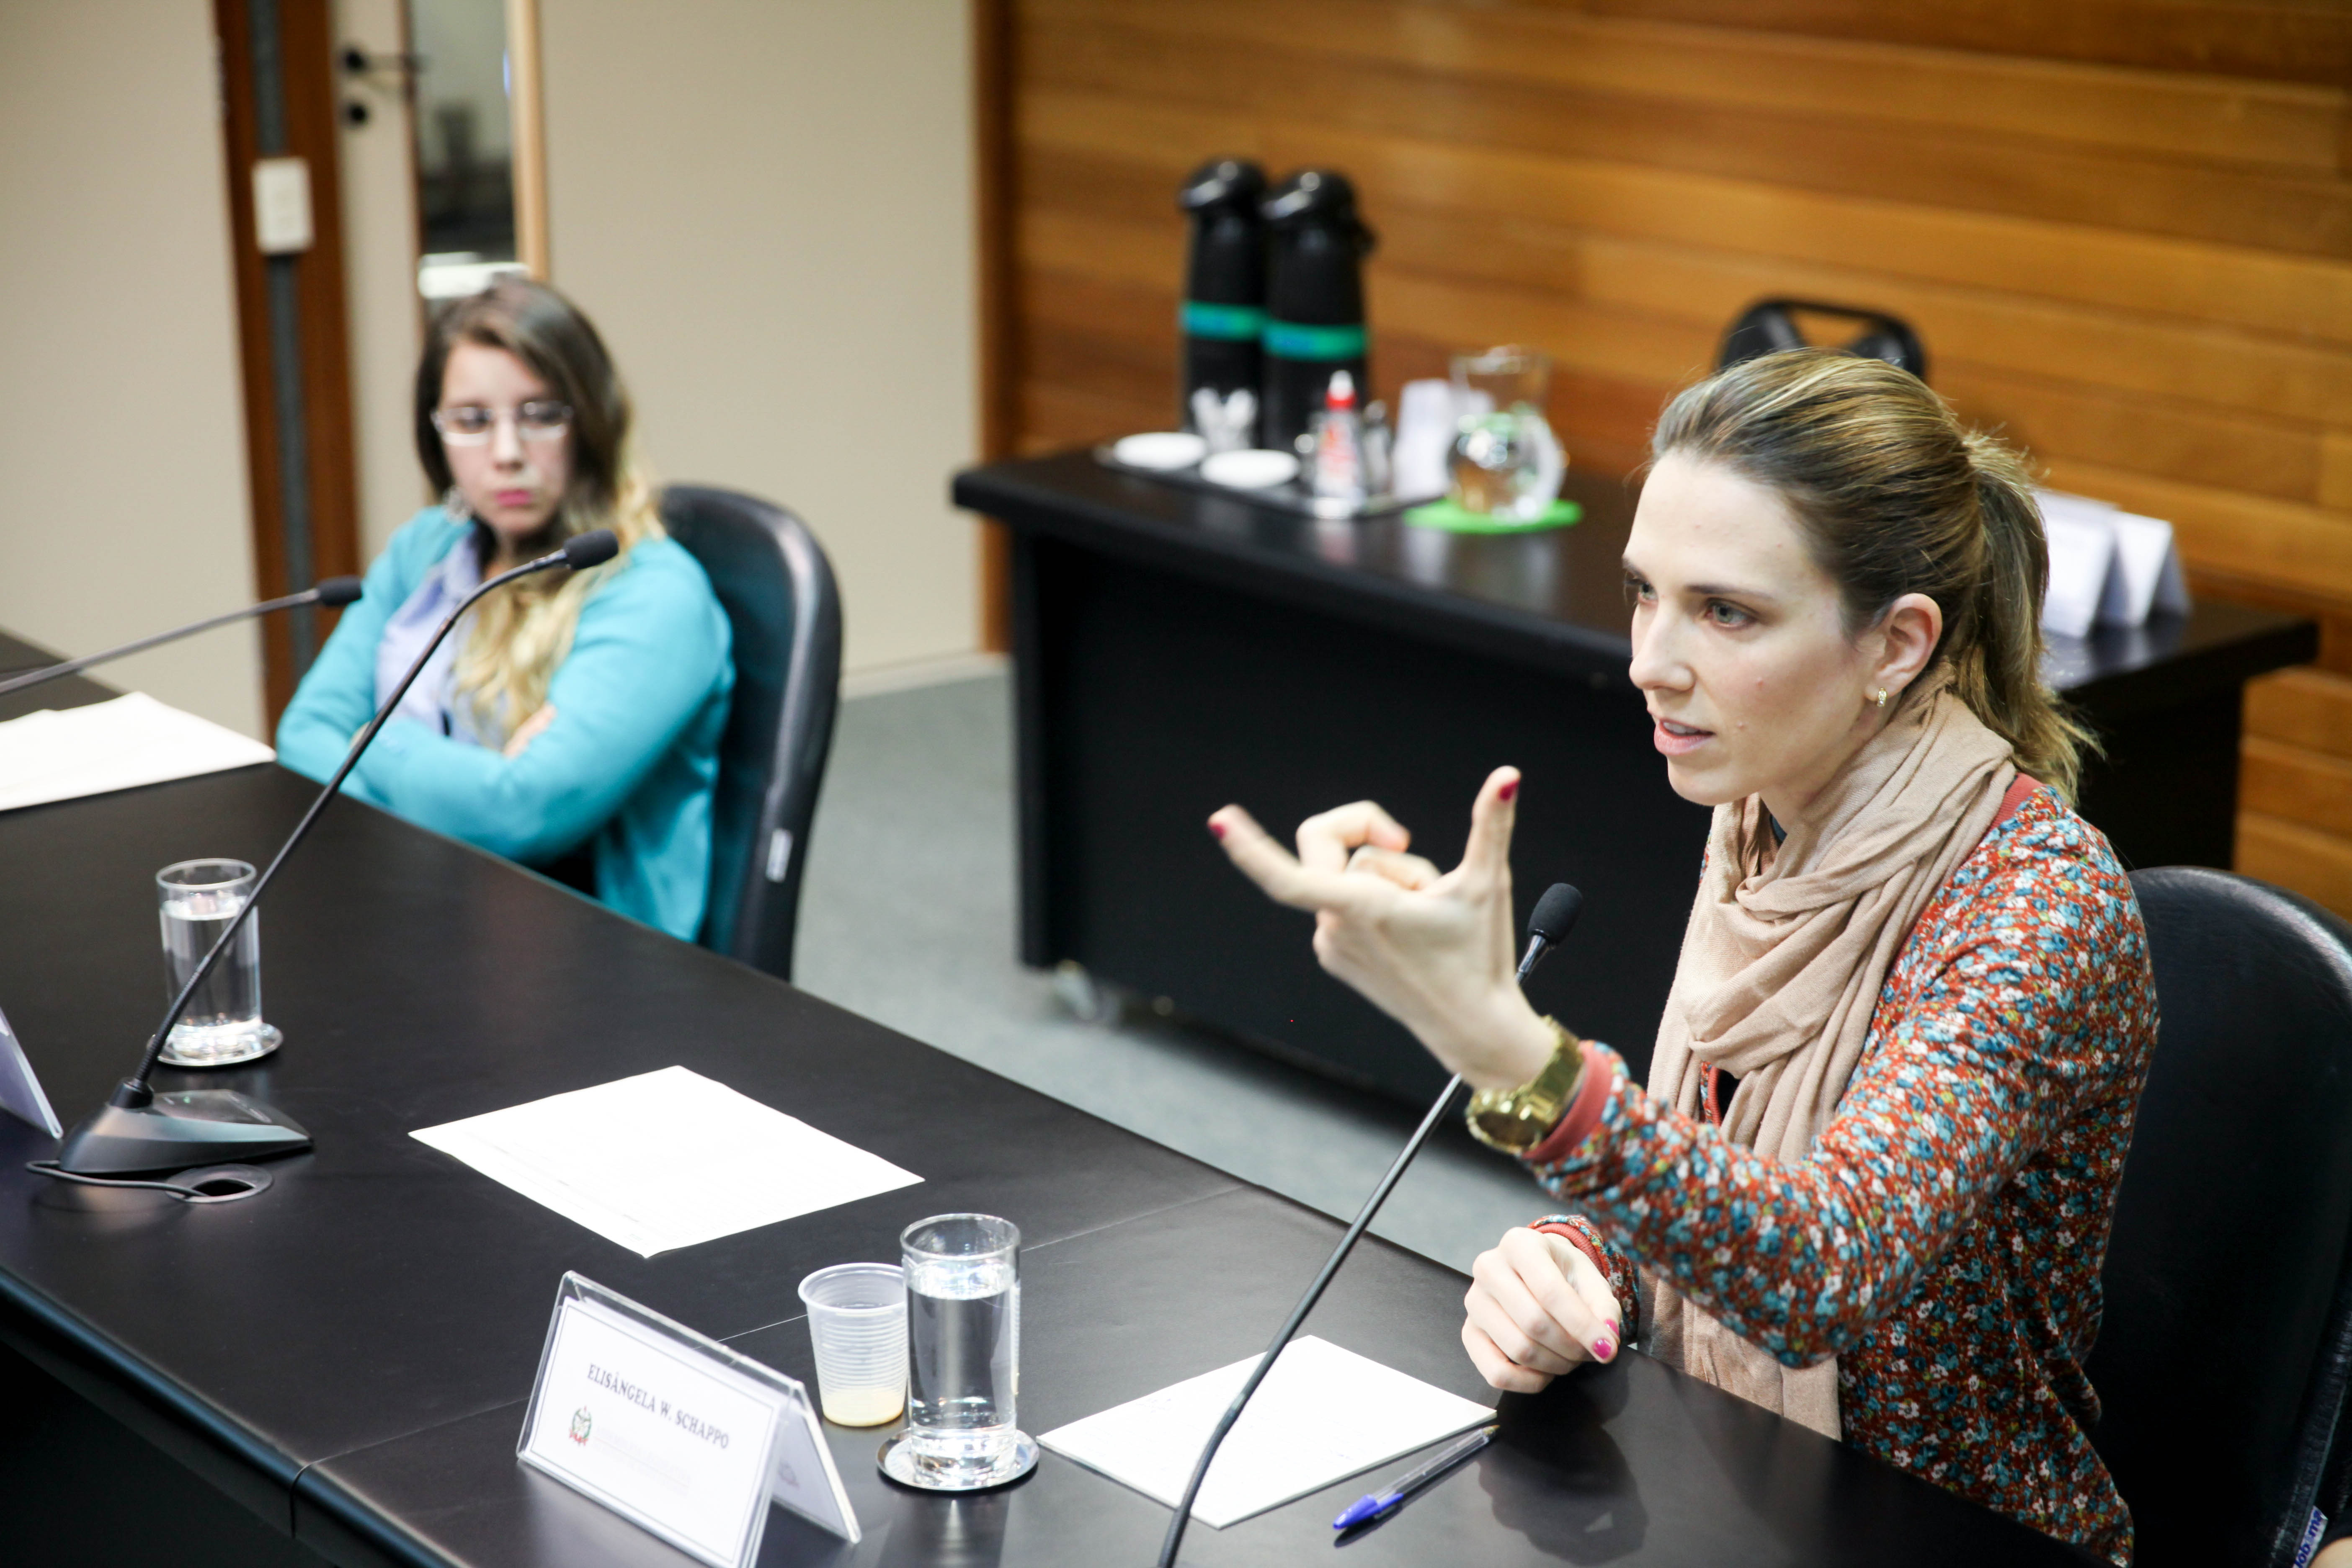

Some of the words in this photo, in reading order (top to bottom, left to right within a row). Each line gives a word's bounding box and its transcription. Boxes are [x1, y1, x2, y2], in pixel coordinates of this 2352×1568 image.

[587, 1364, 655, 1412] ELISÂNGELA
[660, 1400, 672, 1421] W.
[676, 1410, 729, 1449] SCHAPPO
